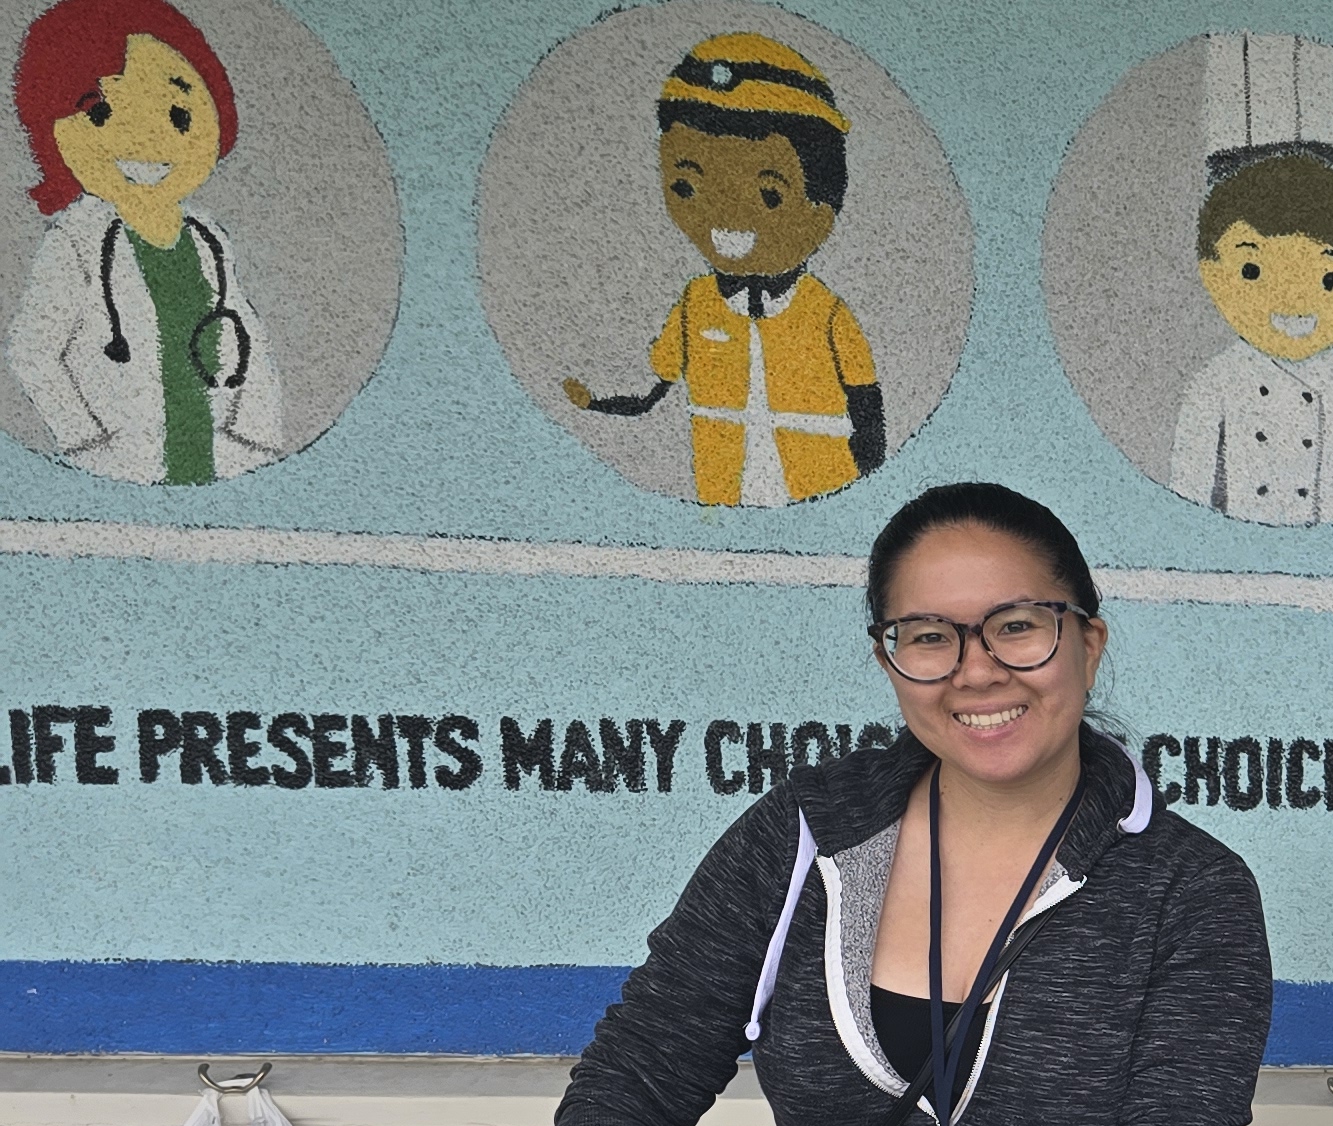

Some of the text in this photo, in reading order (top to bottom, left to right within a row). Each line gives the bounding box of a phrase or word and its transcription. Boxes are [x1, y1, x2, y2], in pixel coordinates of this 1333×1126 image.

[0, 705, 119, 785] IFE
[137, 707, 482, 792] PRESENTS
[500, 716, 687, 793] MANY
